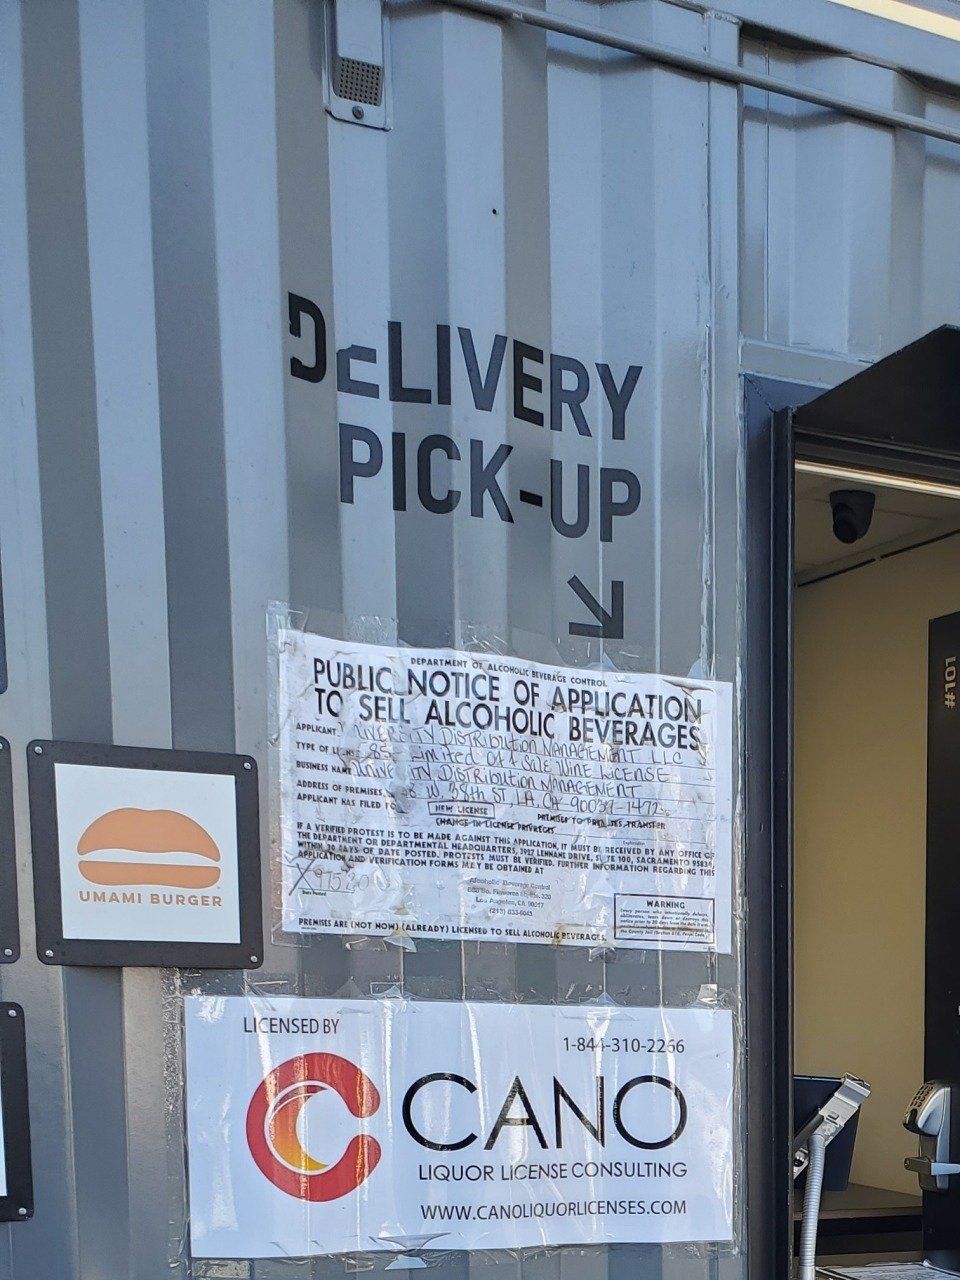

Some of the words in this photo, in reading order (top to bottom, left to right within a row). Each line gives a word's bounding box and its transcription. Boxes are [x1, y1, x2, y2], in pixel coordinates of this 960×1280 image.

[288, 291, 643, 441] DELIVERY
[338, 422, 641, 543] PICK-UP
[410, 657, 468, 668] DEPARTMENT
[487, 662, 530, 677] ALCOHOLIC
[531, 670, 567, 683] BEVERAGE
[570, 677, 608, 687] CONTROL
[944, 656, 957, 709] #101
[313, 657, 392, 694] PUBLIC
[407, 669, 500, 702] NOTICE
[513, 679, 540, 708] OF
[551, 686, 702, 724] APPLICATION
[314, 688, 344, 717] TO
[359, 694, 411, 724] SELL
[424, 699, 555, 739] ALCOHOLIC
[568, 716, 702, 751] BEVERAGES
[296, 741, 316, 751] TYPE
[296, 760, 329, 772] BUSINESS
[331, 762, 352, 775] NAME
[296, 780, 329, 791] ADDRESS
[332, 784, 343, 792] OF
[297, 793, 338, 804] APPLICANT
[341, 798, 356, 807] HAS
[360, 799, 382, 809] FILED
[434, 804, 454, 813] NEW
[457, 805, 489, 815] LICENSE
[297, 821, 303, 830] IF
[307, 822, 312, 831] A
[315, 823, 346, 834] VERIFIED
[347, 827, 385, 838] PROTEST
[387, 830, 395, 838] IS
[398, 831, 411, 839] TO
[427, 832, 452, 841] MADE
[455, 833, 491, 843] AGAINST
[494, 836, 511, 845] THIS
[513, 838, 560, 850] APPLICATION,
[561, 842, 567, 850] IT
[571, 844, 591, 852] MUST
[605, 846, 642, 855] RECEIVED
[645, 848, 654, 856] BY
[660, 848, 674, 857] ANY
[678, 849, 701, 859] OFFICE
[297, 831, 311, 840] THE
[313, 832, 363, 845] DEPARTMENT
[365, 838, 378, 846] OR
[381, 839, 448, 850] DEPARTMENTAL
[451, 842, 518, 855] HEADQUARTERS,
[568, 853, 594, 862] DRIVE,
[618, 856, 634, 865] 100,
[636, 856, 690, 867] SACRAMENTO
[297, 841, 323, 851] WITHIN
[327, 843, 336, 851] 30
[363, 847, 374, 855] OF
[378, 848, 401, 856] DATE
[404, 849, 440, 858] POSTED.
[443, 852, 485, 861] PROTESTS
[488, 854, 509, 863] MUST
[513, 855, 522, 864] BE
[524, 857, 555, 867] VERIFIED.
[557, 860, 589, 870] FURTHER
[592, 862, 649, 873] INFORMATION
[700, 869, 715, 877] THIS
[298, 850, 346, 861] APPLICATION
[348, 853, 366, 862] AND
[369, 856, 427, 867] VERIFICATION
[429, 859, 459, 868] FORMS
[484, 862, 494, 871] BE
[496, 863, 533, 873] OBTAINED
[534, 866, 544, 875] AT
[79, 891, 143, 905] UMAMI
[149, 893, 223, 907] BURGER
[646, 900, 685, 909] WARNING
[298, 917, 332, 927] PREMISES
[333, 919, 348, 928] ARE
[351, 920, 371, 929] (NOT
[375, 921, 399, 931] NOW)
[401, 923, 449, 933] (ALREADY)
[451, 926, 488, 935] LICENSED
[490, 927, 503, 936] TO
[505, 928, 521, 937] SELL
[523, 930, 560, 939] ALCOHOLIC
[243, 1016, 319, 1035] LICENSED
[321, 1017, 340, 1034] BY
[562, 1036, 685, 1055] 1-844-310-2266
[402, 1071, 688, 1152] CANO
[418, 1163, 495, 1182] LIQUOR
[500, 1163, 569, 1181] LICENSE
[572, 1161, 688, 1180] CONSULTING
[420, 1199, 687, 1221] WWW.CANOLIQUORLICENSES.COM
